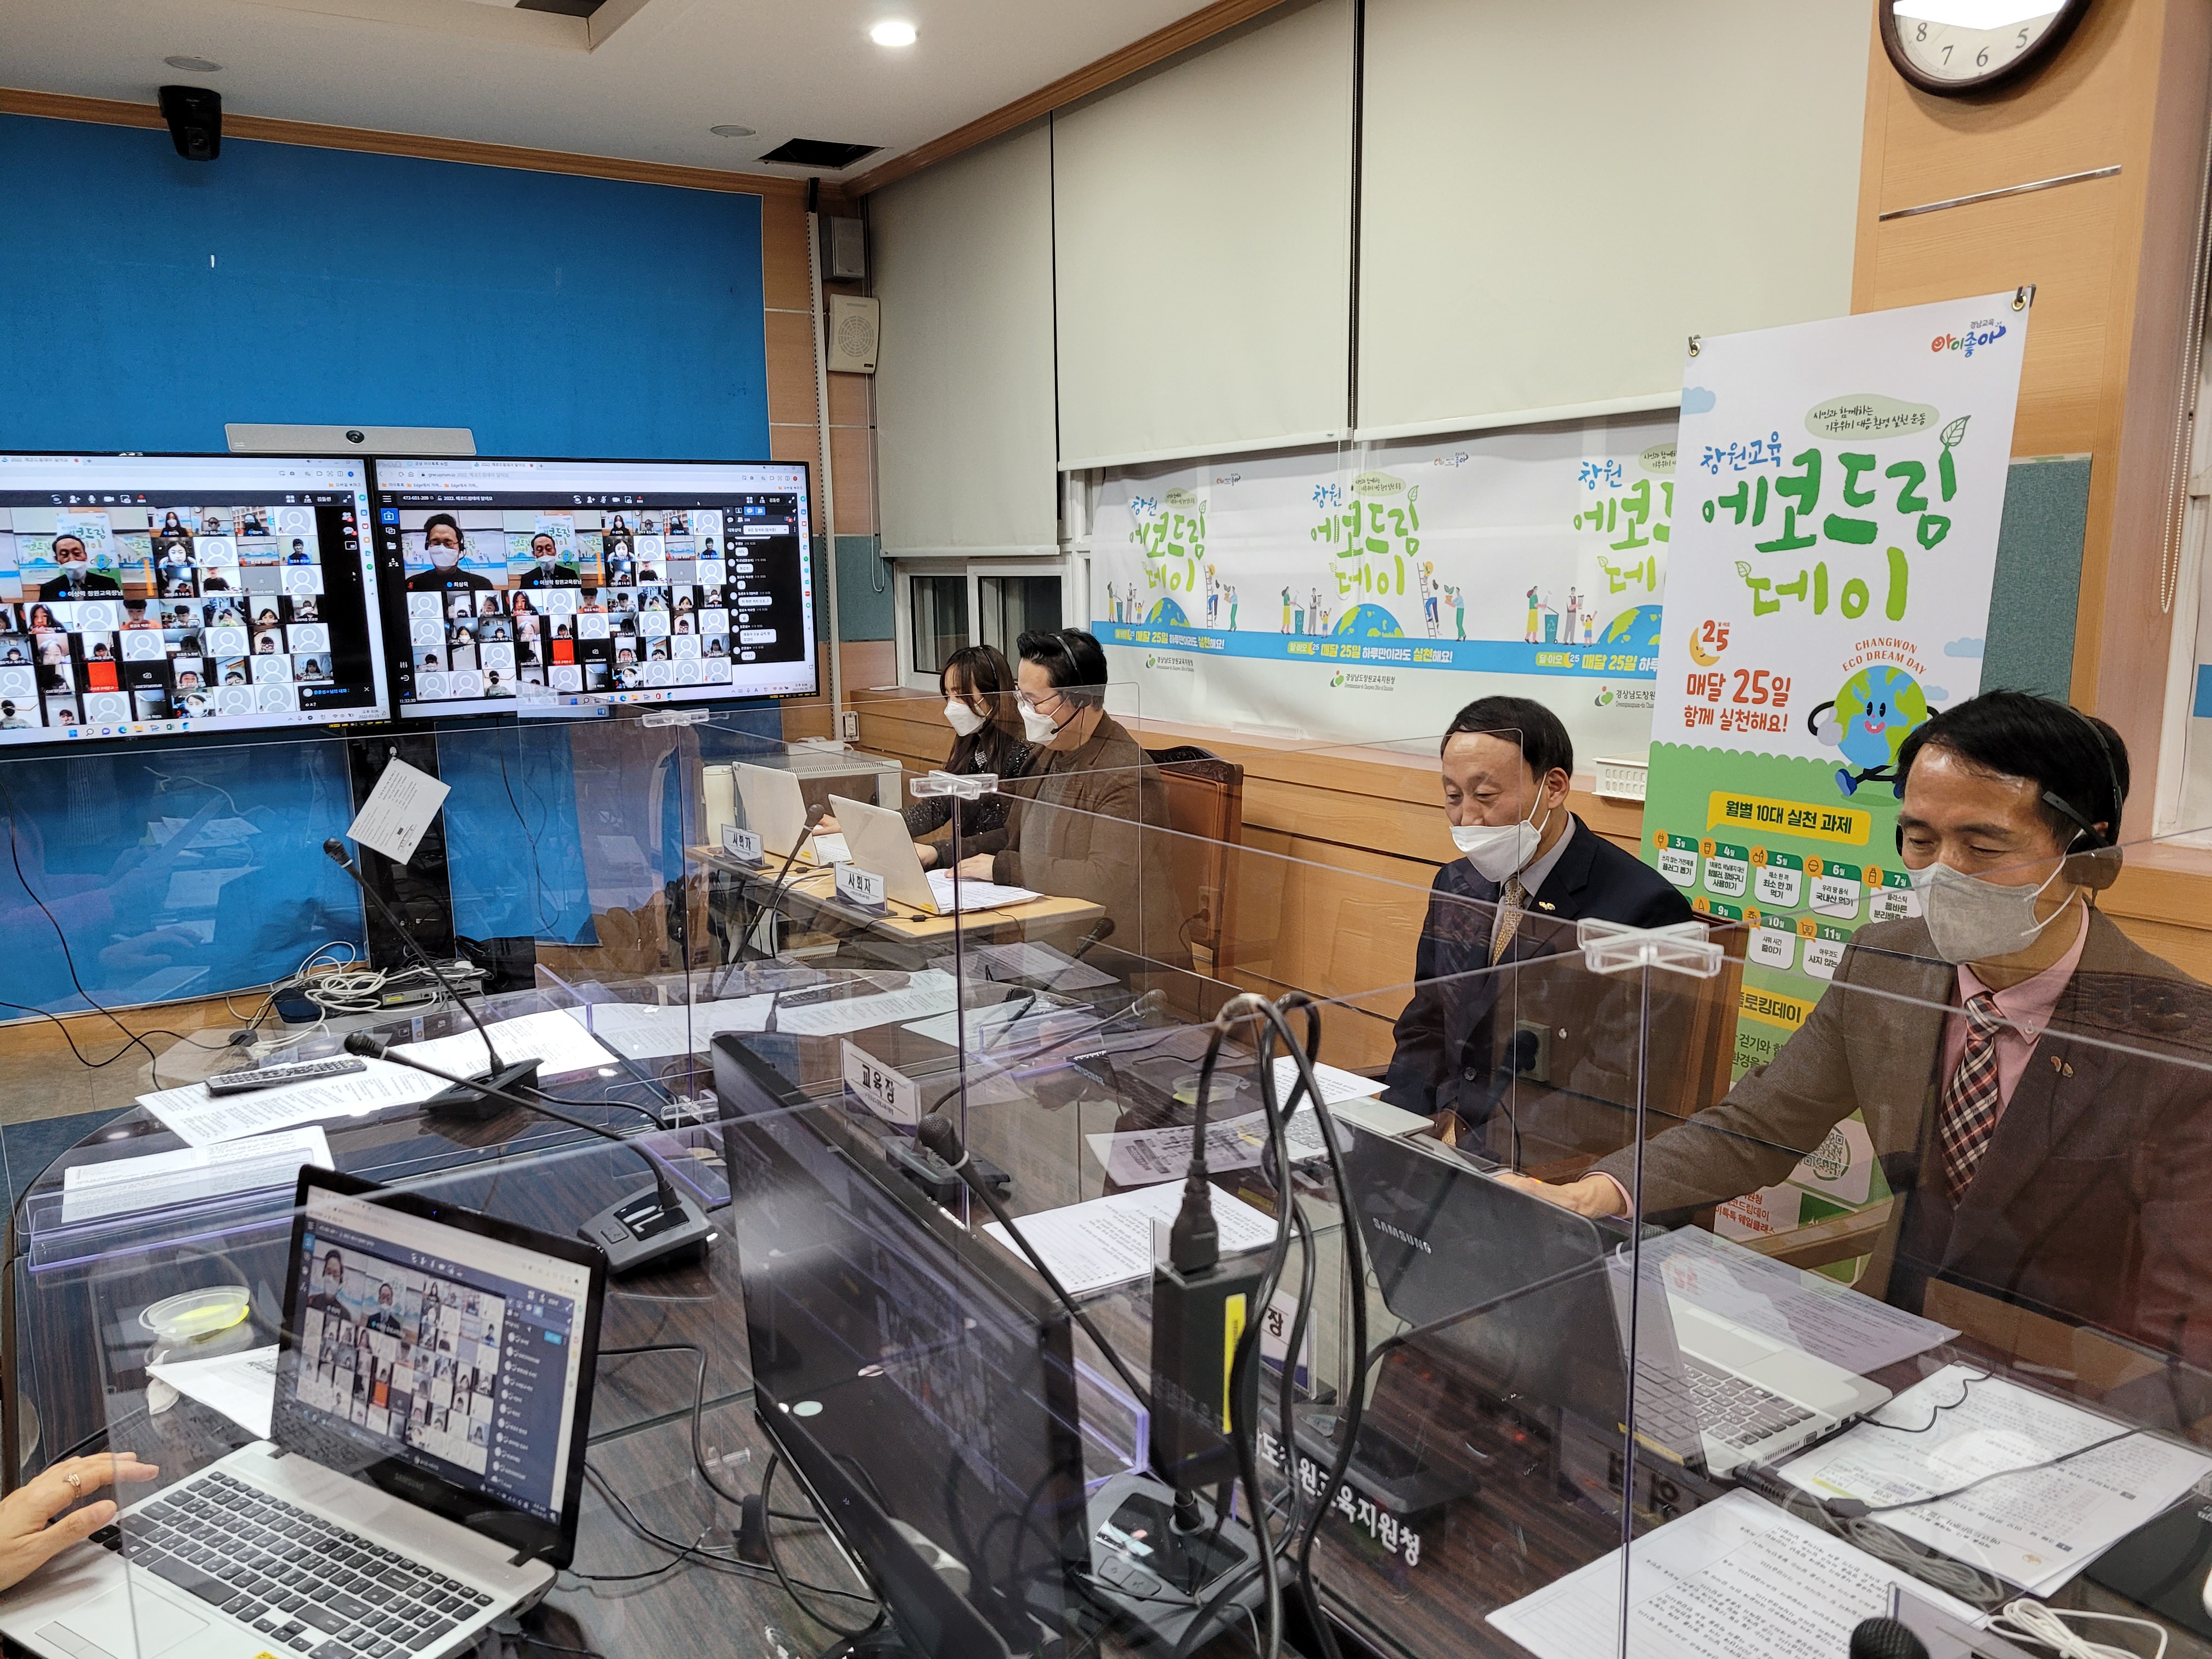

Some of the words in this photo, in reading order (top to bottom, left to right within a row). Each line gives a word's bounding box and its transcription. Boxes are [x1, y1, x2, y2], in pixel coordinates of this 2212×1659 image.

[1916, 22, 1927, 42] 8
[2016, 27, 2030, 49] 5
[1942, 45, 1954, 65] 7
[1976, 46, 1989, 67] 6
[1970, 319, 1994, 329] 경남교육
[1932, 325, 2006, 358] 아이좋아
[1814, 409, 1838, 419] 시민과
[1839, 405, 1874, 418] 함께하는
[1826, 420, 1854, 432] 기후위기
[1857, 417, 1872, 430] 대응
[1873, 415, 1890, 430] 환경
[1892, 414, 1909, 428] 실천
[1910, 413, 1926, 426] 운동
[1700, 431, 1782, 475] 창원교육
[1578, 460, 1622, 490] 창원
[1312, 483, 1342, 507] 창원
[1702, 445, 1957, 550] 에코드림
[1131, 495, 1158, 516] 창원
[1130, 510, 1207, 560] 에코드림
[1311, 498, 1420, 557] 에코드림
[1146, 558, 1195, 592] 데이
[1334, 555, 1405, 596] 데이
[1605, 555, 1666, 594] 데
[1747, 546, 1909, 621] 데이
[1136, 630, 1150, 642] 매달
[1152, 631, 1168, 644] 25일
[1169, 634, 1198, 647] 하루만이라도
[1198, 636, 1224, 650] 실천해요!
[1855, 637, 1918, 654] CHANGWON
[1321, 644, 1339, 658] 매달
[1340, 645, 1361, 659] 25일
[1362, 647, 1411, 661] 하루만이라도
[1413, 647, 1453, 663] 실천해요!
[1570, 654, 1580, 663] 25
[1582, 653, 1608, 670] 매달
[1609, 654, 1638, 672] 25일
[1842, 656, 1863, 672] ECO
[1866, 651, 1905, 663] DREAM
[1906, 658, 1927, 675] DAY
[1346, 673, 1395, 685] 경상남도창원교육지원청
[1686, 673, 1726, 702] 매달
[1733, 669, 1791, 707] 25일
[1684, 705, 1714, 727] 함께
[1720, 708, 1788, 732] 실천해요!
[1726, 800, 1753, 820] 월별
[1757, 805, 1784, 825] 10대
[1787, 809, 1817, 830] 실천
[1820, 814, 1853, 835] 과제
[732, 833, 752, 851] 사회자
[1675, 838, 1686, 848] 3월
[1724, 846, 1735, 857] 4월
[1776, 855, 1788, 866] 5월
[1832, 865, 1846, 876] 6월
[849, 873, 871, 894] 사회자
[1712, 879, 1737, 890] 사용하기
[1763, 879, 1776, 888] 최소
[1778, 882, 1785, 890] 한
[1785, 883, 1793, 891] 끼
[1894, 874, 1906, 887] 7월
[1770, 889, 1784, 899] 먹기
[1816, 892, 1837, 904] 국내산
[1838, 896, 1853, 906] 먹기
[1718, 905, 1729, 917] 9월
[1885, 902, 1908, 914] 올바른
[1769, 917, 1785, 928] 10월
[1824, 928, 1841, 940] 11월
[1808, 955, 1822, 965] 사지
[1819, 948, 1838, 958] 아무것도
[1739, 1034, 1771, 1054] 걷기와
[862, 1064, 894, 1104] 교육장
[1745, 1193, 1763, 1205] 원청
[1716, 1205, 1736, 1222] 이톡톡
[1727, 1199, 1769, 1221] 코드림데이
[1373, 1217, 1432, 1254] SAMSUNG
[1257, 1429, 1420, 1566] 도원육지원청
